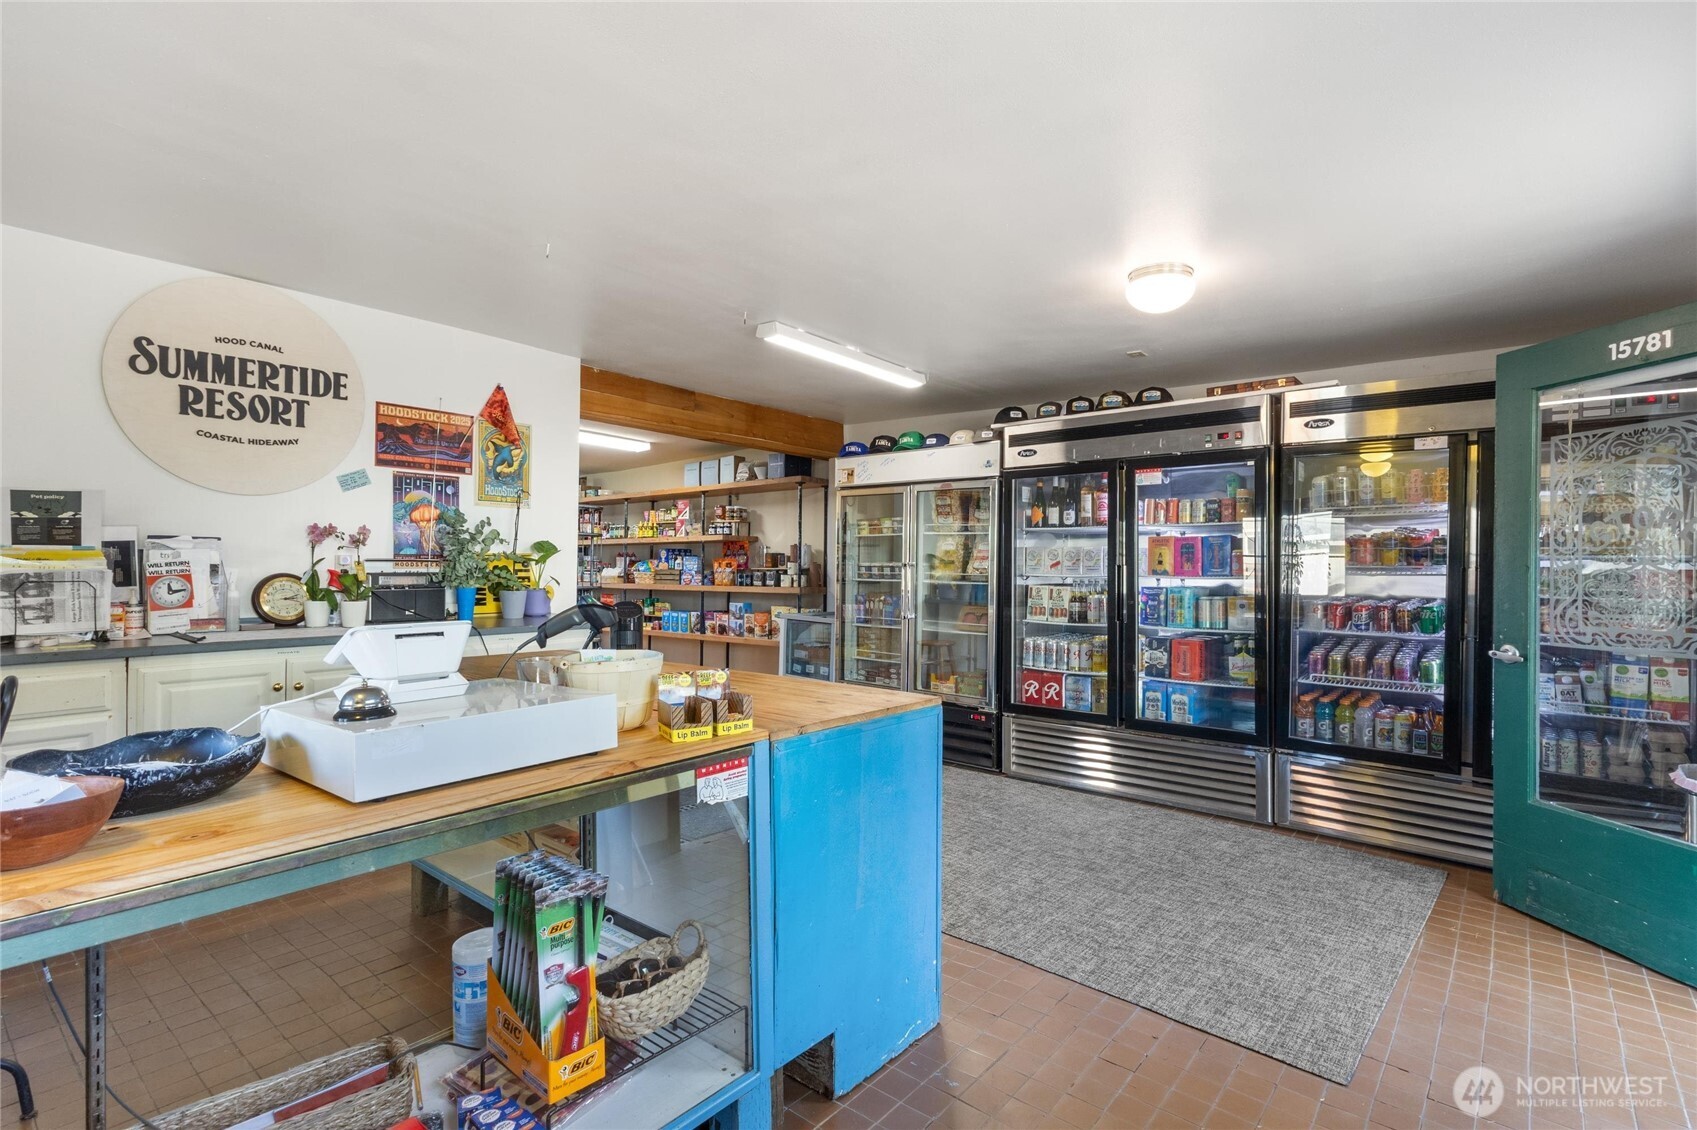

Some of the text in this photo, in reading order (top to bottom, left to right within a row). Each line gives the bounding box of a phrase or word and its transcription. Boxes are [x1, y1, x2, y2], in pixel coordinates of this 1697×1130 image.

[214, 336, 284, 354] HOOD CANAL
[1608, 330, 1672, 361] 15781
[128, 336, 348, 400] SUMMERTIDE
[178, 384, 310, 428] RESORT
[379, 404, 471, 426] HOODSTOCK 2025
[196, 430, 300, 446] COASTAL HIDEAWAY
[164, 560, 190, 568] RETURN
[1024, 680, 1040, 698] R
[1044, 682, 1060, 700] R
[690, 730, 708, 738] Balm
[733, 722, 750, 731] Balm
[1339, 724, 1350, 733] G
[702, 758, 745, 772] WARNING
[550, 934, 566, 942] Multi
[550, 938, 574, 951] purpose
[502, 1018, 522, 1040] BIC
[570, 1054, 594, 1074] BIC
